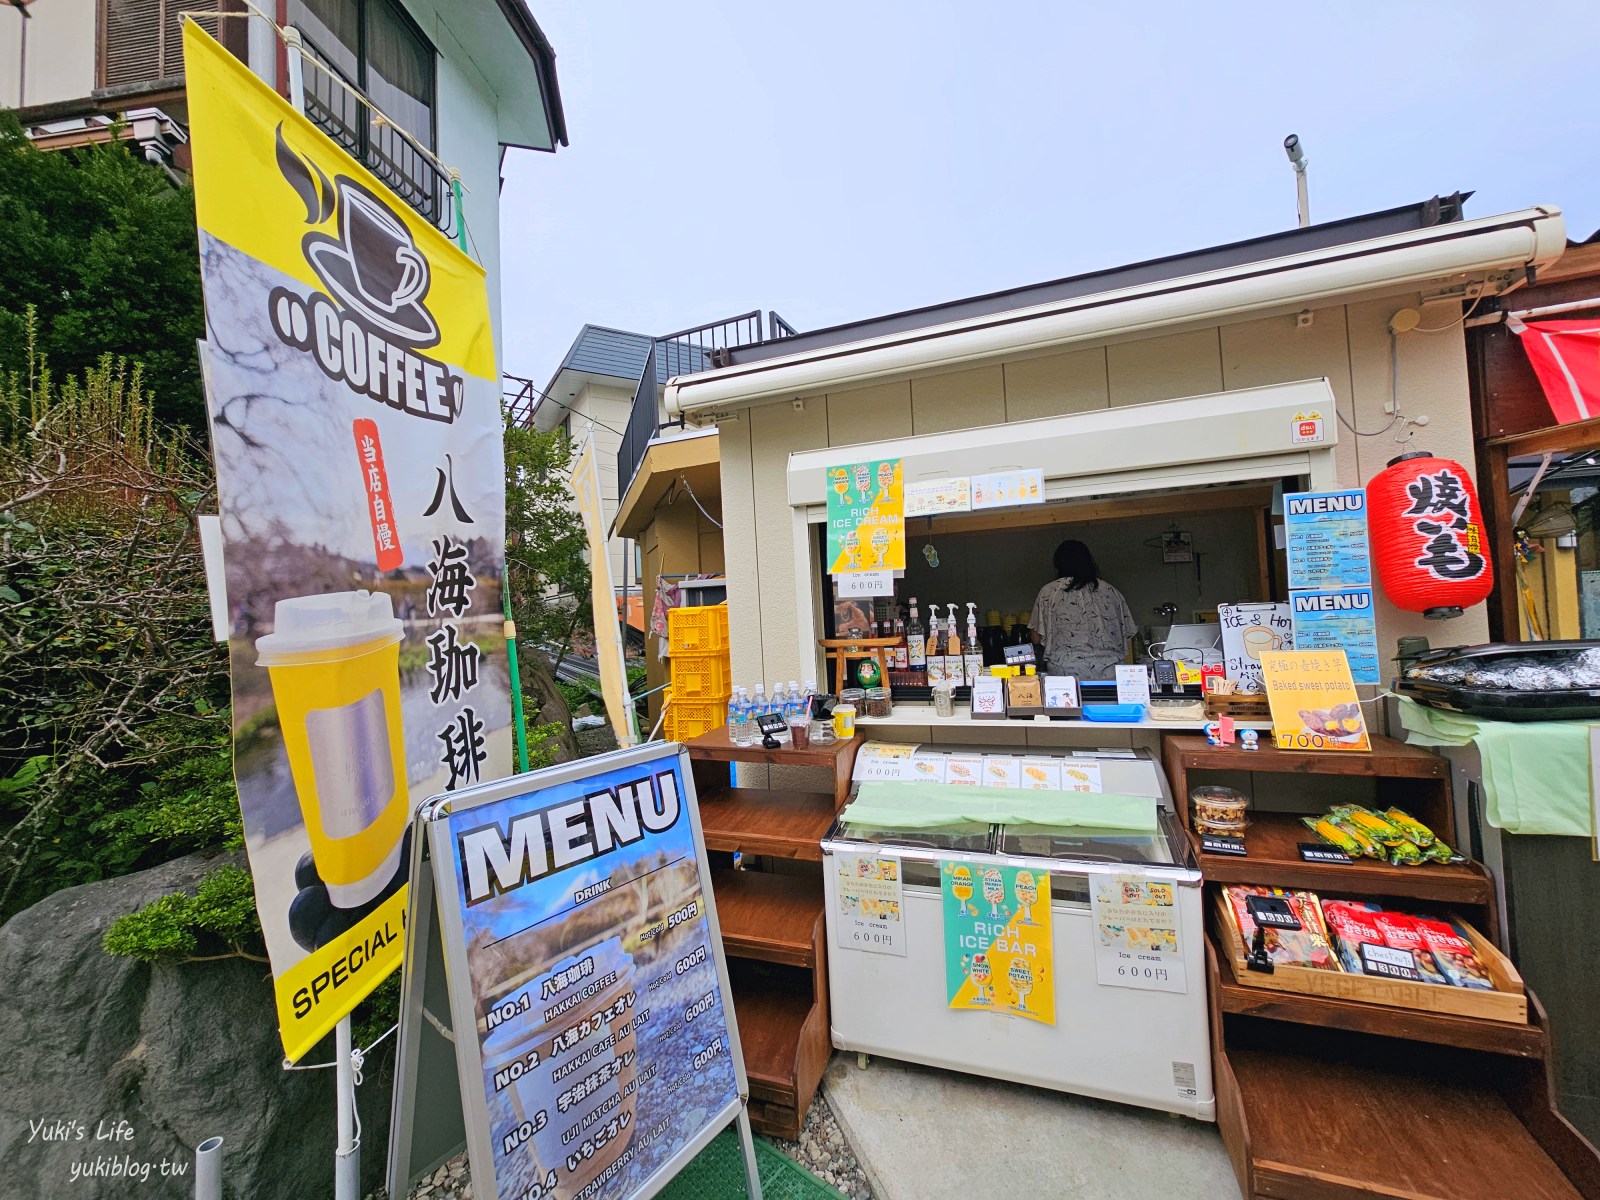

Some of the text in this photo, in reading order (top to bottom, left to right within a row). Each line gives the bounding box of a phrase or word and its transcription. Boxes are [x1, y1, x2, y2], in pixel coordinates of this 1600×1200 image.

[312, 298, 452, 419] COFFEE
[360, 434, 396, 552] 当店自慢
[1289, 493, 1363, 515] MENU
[833, 514, 899, 529] ICE CREAM
[1295, 592, 1370, 613] MENU
[421, 453, 487, 792] 八海珈琲
[1223, 614, 1248, 628] ICE
[1272, 680, 1351, 693] Baked sweet potato
[459, 770, 681, 905] MENU
[574, 878, 612, 904] DRINK
[1015, 883, 1037, 891] PEACH
[667, 901, 698, 930] 500円
[675, 944, 707, 976] 600円
[959, 934, 1037, 958] ICE BAR
[1137, 954, 1162, 962] cream
[292, 922, 398, 1020] SPECIAL
[541, 956, 595, 1001] 八海珈琲
[1008, 972, 1033, 981] POTATO
[1010, 967, 1030, 976] SWEET
[1118, 965, 1168, 981] 600円
[486, 992, 531, 1031] NO.1
[543, 971, 617, 1023] HAKKAI COFFEE
[684, 990, 715, 1024] 600円
[551, 990, 637, 1058] 八海カフェオレ
[552, 1008, 651, 1083] HAKKAI CAFE AU LAIT
[692, 1037, 723, 1072] 600円
[494, 1051, 540, 1092] NO.2
[557, 1049, 635, 1113] 宇治抹茶オレ
[561, 1063, 658, 1146] UJI MATCHA AU LAIT
[503, 1109, 548, 1156] NO.3
[566, 1110, 632, 1173] いちごオレ
[637, 1133, 651, 1150] AU
[652, 1115, 671, 1140] LAIT
